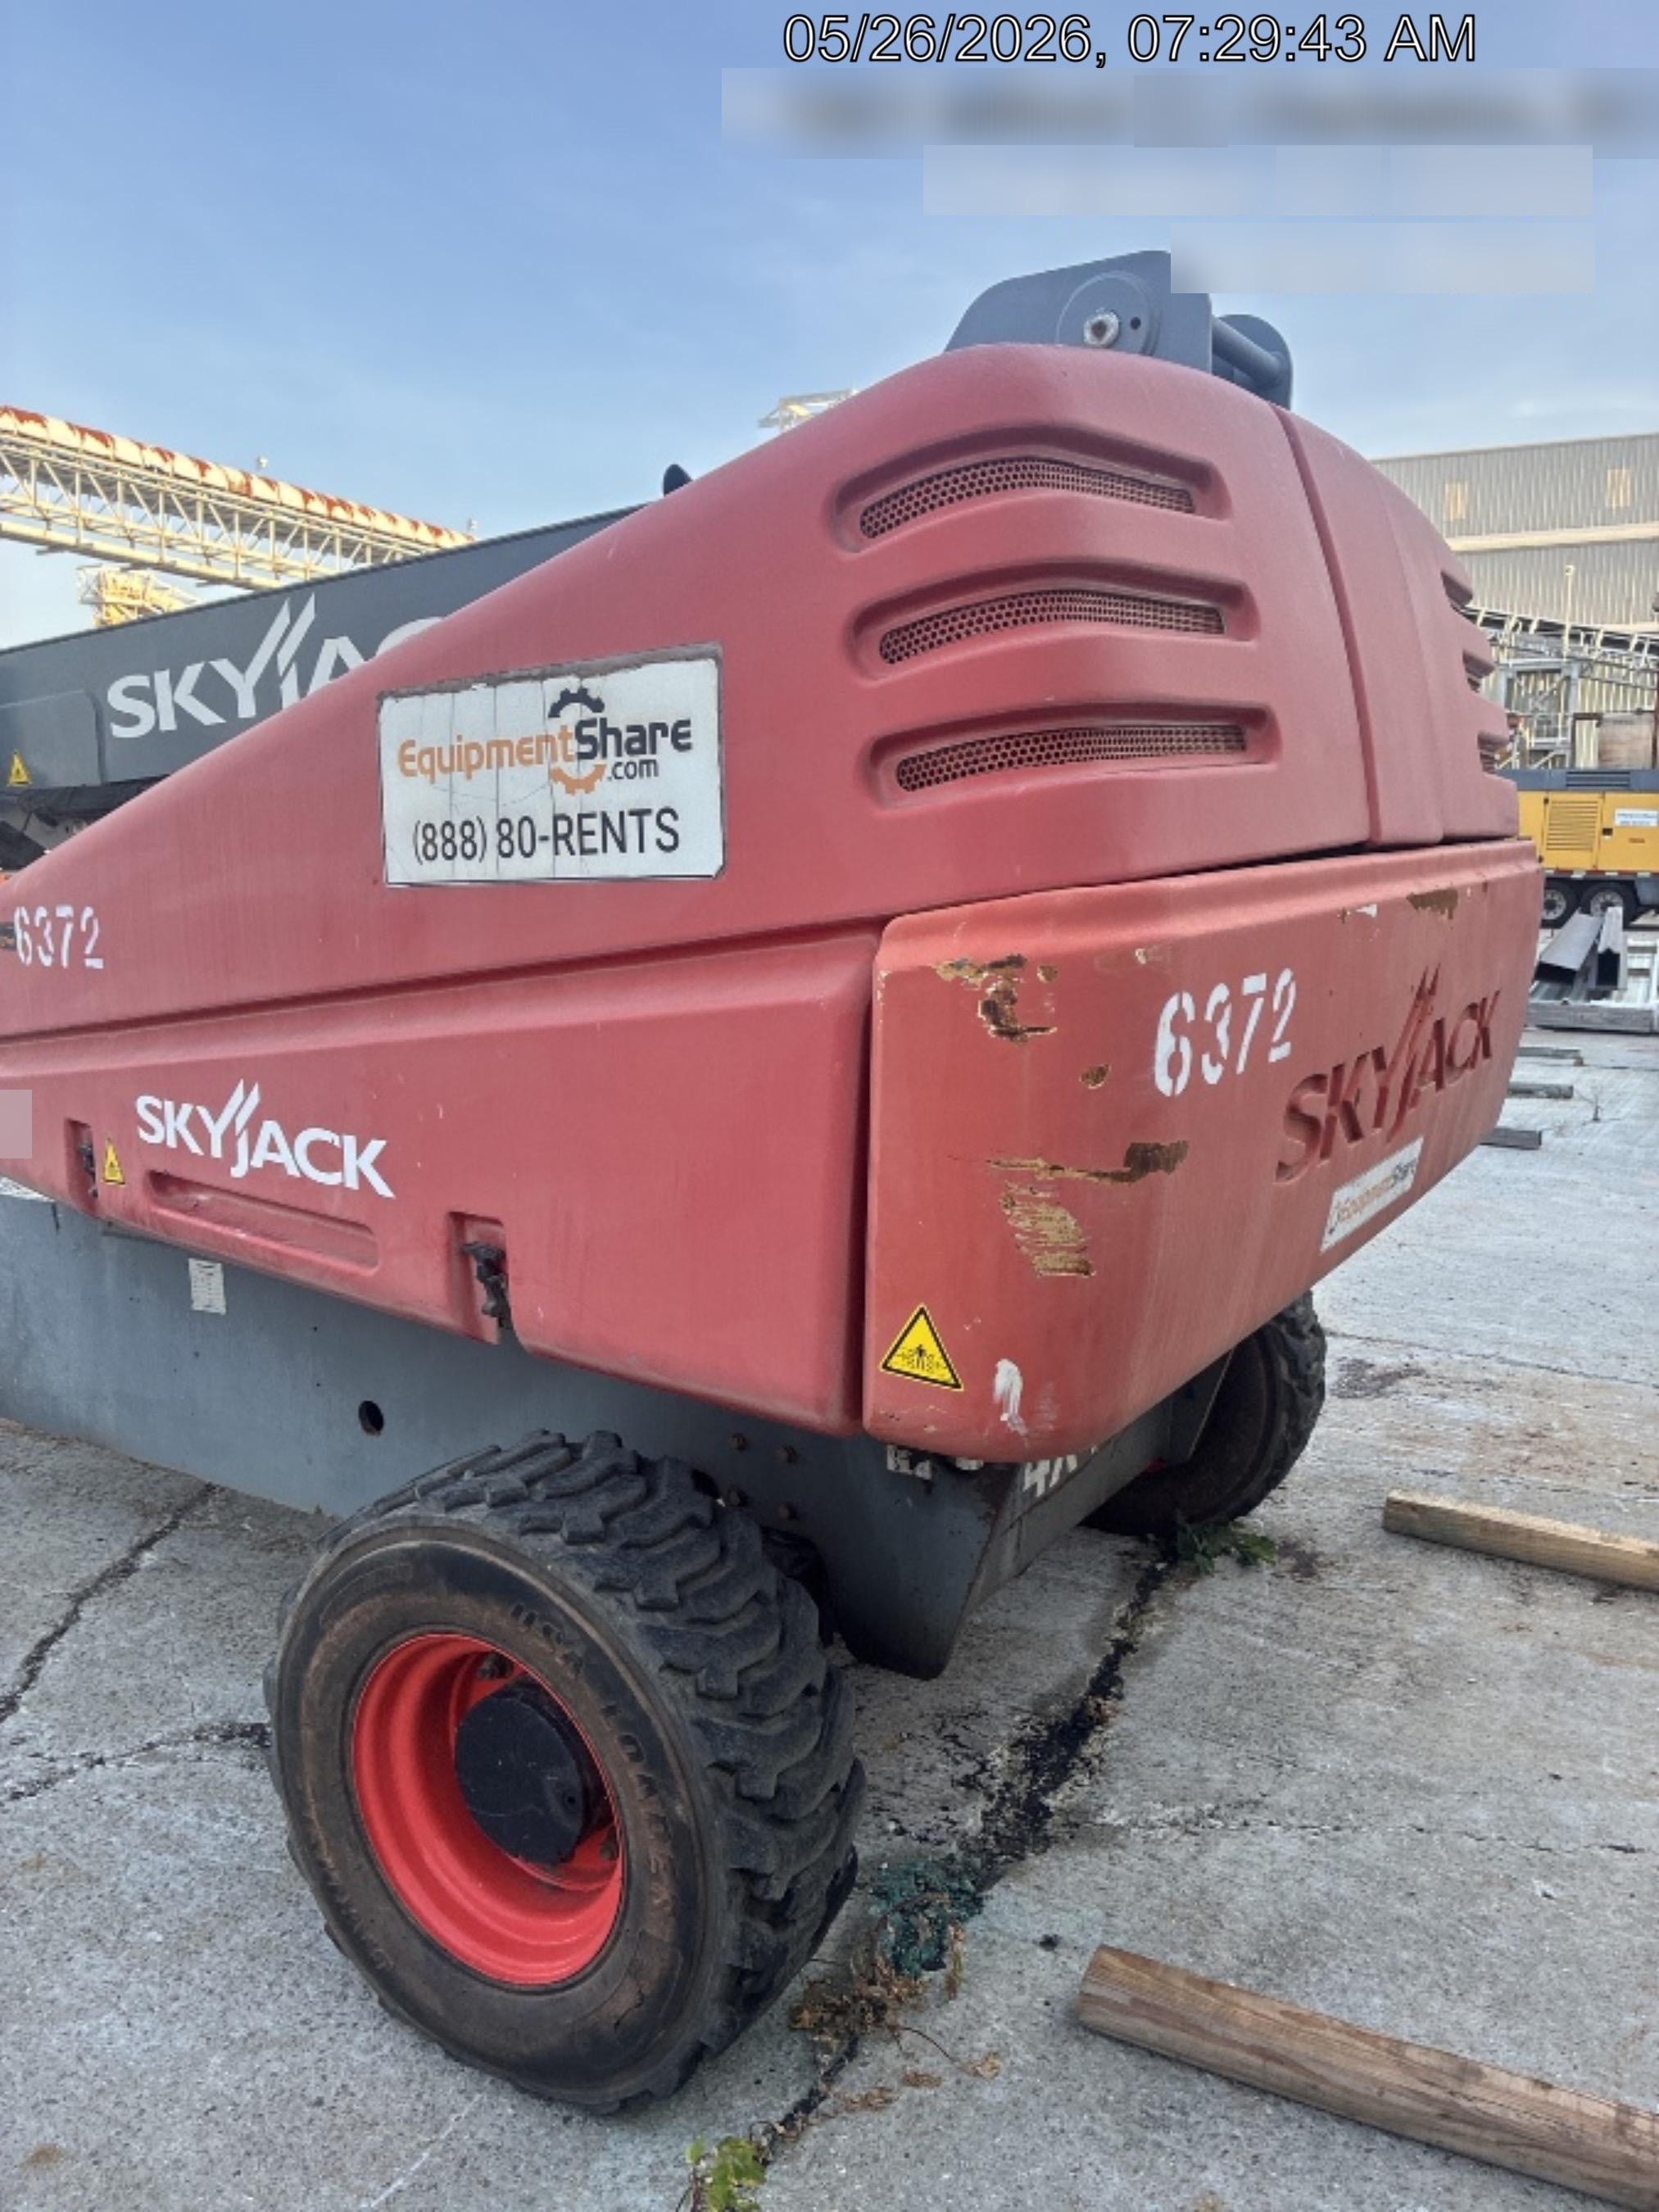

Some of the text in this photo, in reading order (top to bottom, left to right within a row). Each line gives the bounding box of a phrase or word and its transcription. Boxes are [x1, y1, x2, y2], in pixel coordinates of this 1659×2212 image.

[398, 718, 692, 784] EquipmentShare
[607, 758, 660, 781] .com
[413, 806, 680, 866] (888) 80-RENTS
[14, 904, 104, 969] 6372
[1154, 968, 1297, 1098] 6372
[1275, 963, 1500, 1185] SKYJACK
[135, 1078, 395, 1199] SKYJACK
